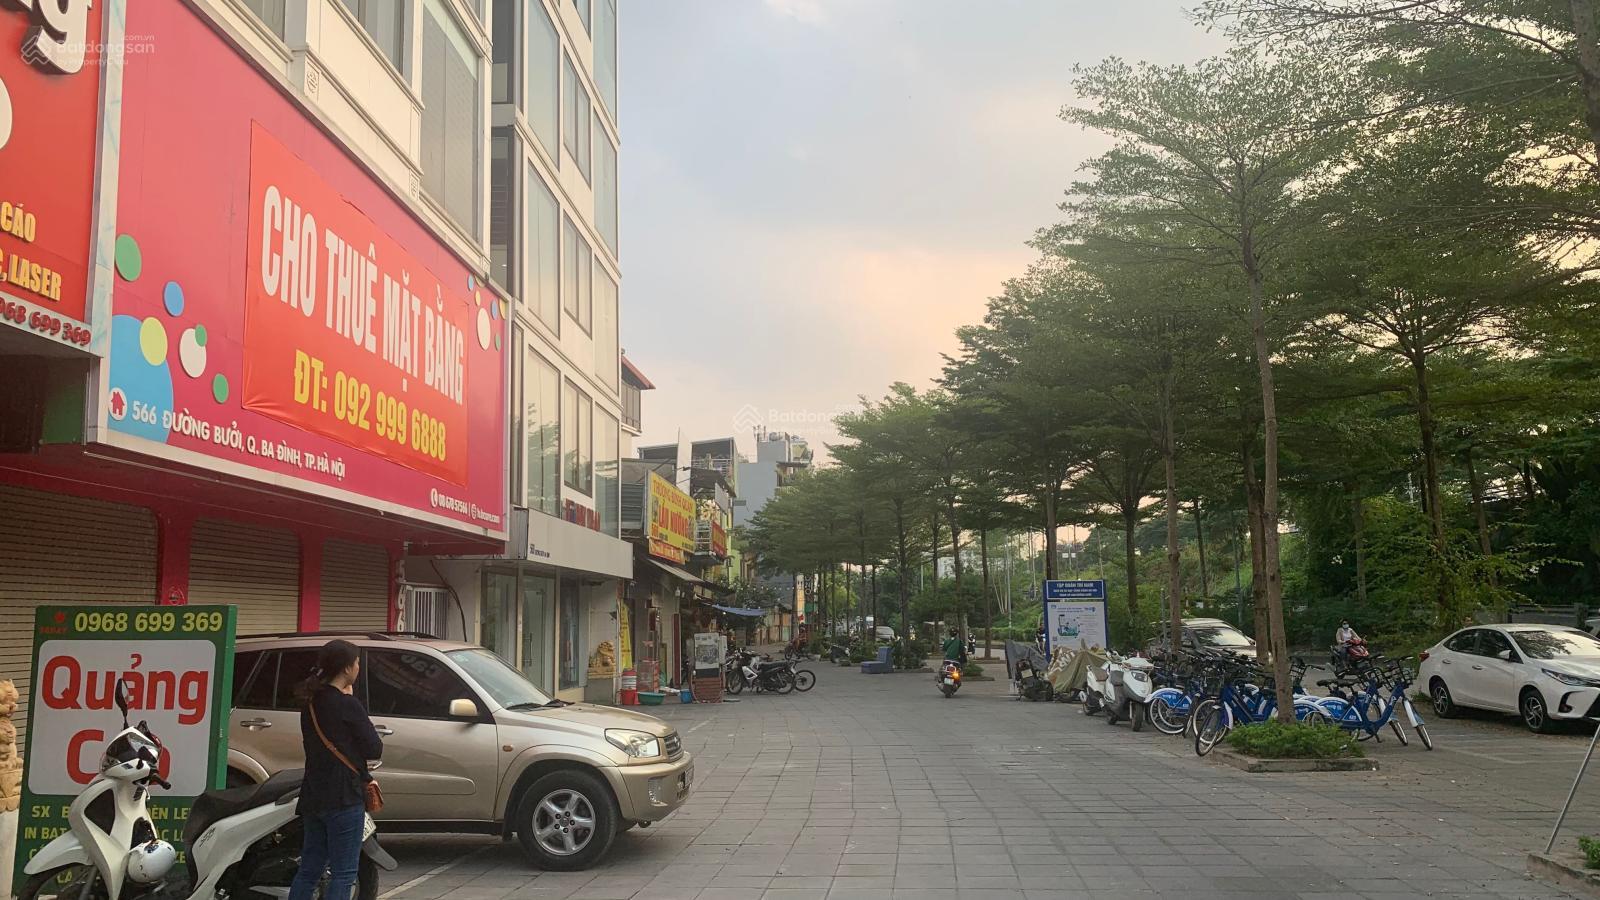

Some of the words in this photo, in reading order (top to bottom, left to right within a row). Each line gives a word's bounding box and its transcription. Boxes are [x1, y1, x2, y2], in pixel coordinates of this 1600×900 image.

[1, 202, 36, 242] CÁO
[8, 254, 62, 301] LASER
[262, 185, 318, 317] CHO
[325, 242, 378, 354] THUÊ
[383, 269, 421, 392] MẶT
[425, 284, 464, 405] BẰNG
[29, 311, 61, 335] 699
[62, 322, 92, 346] 369
[294, 349, 328, 413] ĐT:
[334, 370, 370, 431] 092
[376, 391, 407, 445] 999
[411, 408, 446, 462] 6888
[132, 401, 157, 425] 566
[162, 408, 210, 441] ĐƯỜNG
[213, 420, 244, 452] BƯỞI,
[247, 436, 259, 454] Q.
[261, 440, 274, 458] BA
[277, 440, 303, 467] ĐÌNH,
[331, 458, 346, 481] NỘI
[75, 612, 128, 632] 0968
[135, 612, 175, 632] 699
[181, 611, 223, 632] 369
[41, 653, 209, 725] Quảng
[24, 827, 37, 840] IN
[31, 805, 50, 818] SX
[173, 807, 191, 820] LE
